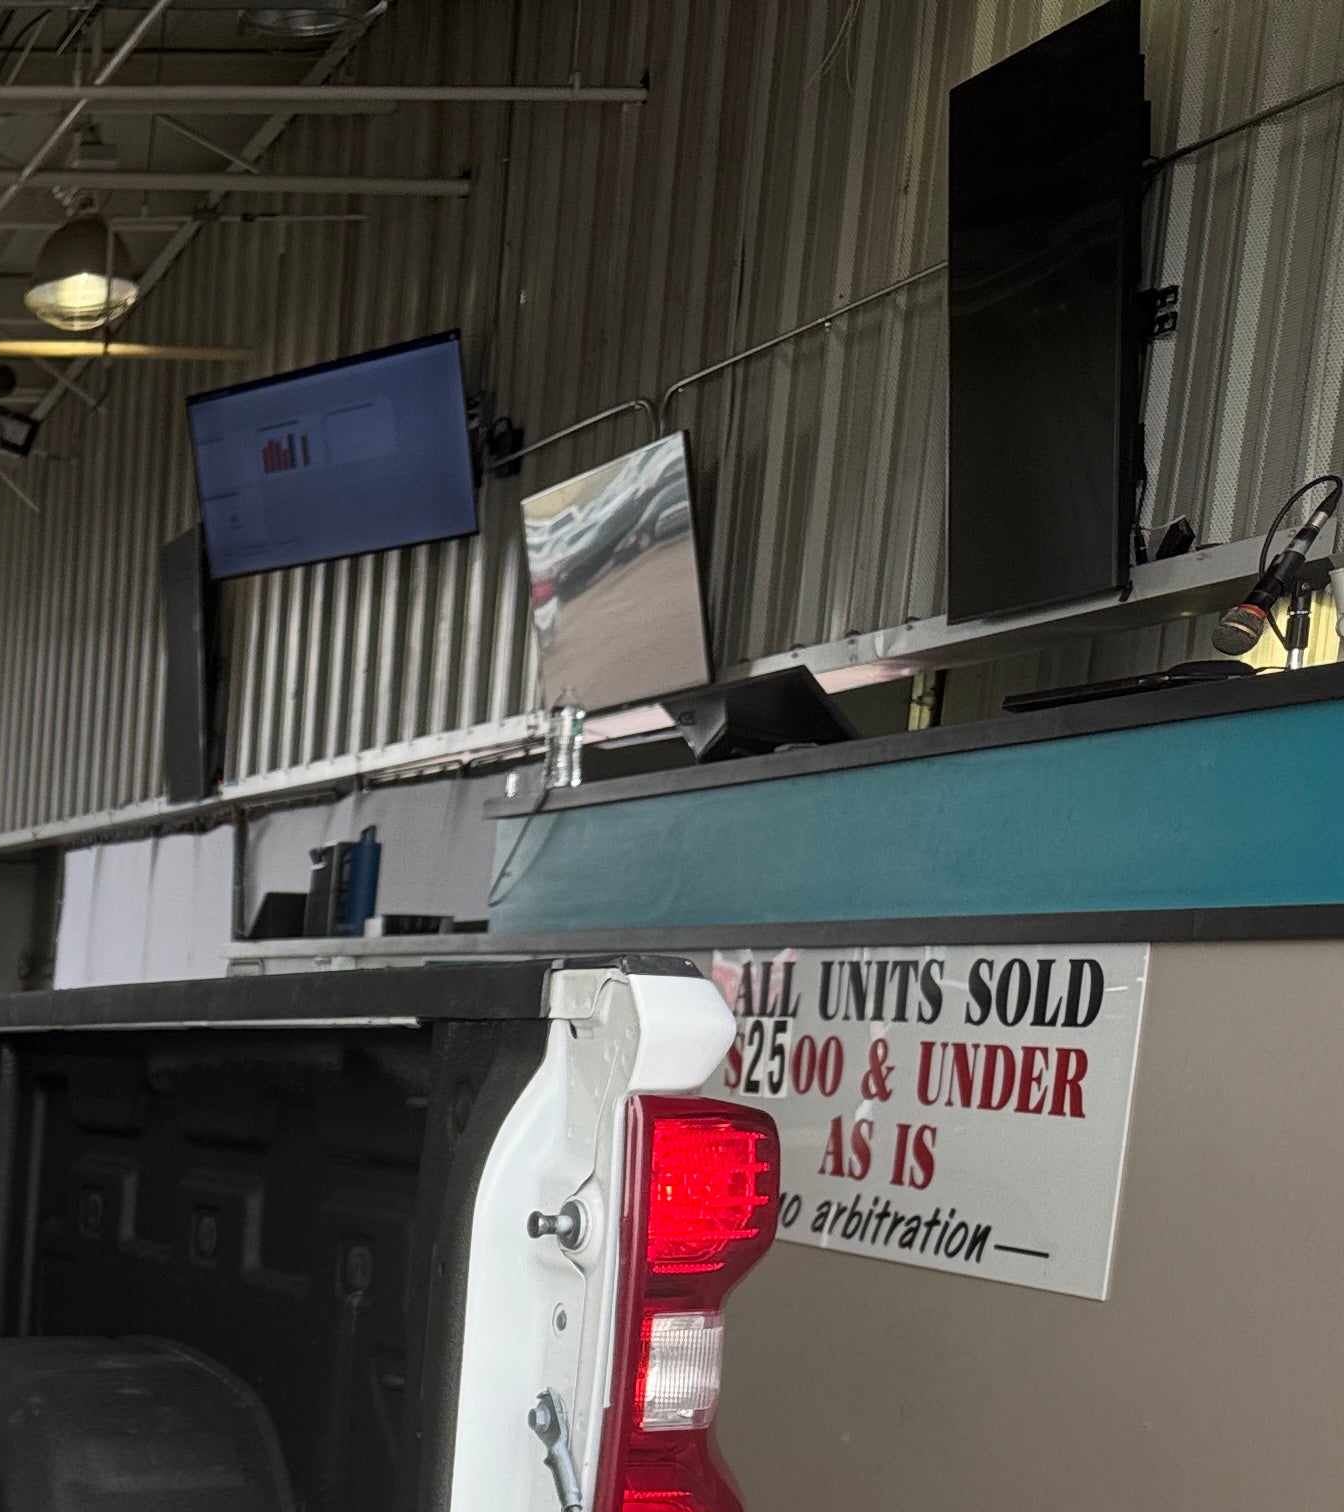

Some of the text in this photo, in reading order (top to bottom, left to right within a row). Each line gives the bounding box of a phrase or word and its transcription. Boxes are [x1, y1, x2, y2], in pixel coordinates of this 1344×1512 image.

[733, 957, 1106, 1028] ALL UNITS SOLD
[861, 1037, 896, 1103] &
[917, 1040, 1089, 1119] UNDER
[818, 1115, 938, 1190] AS IS
